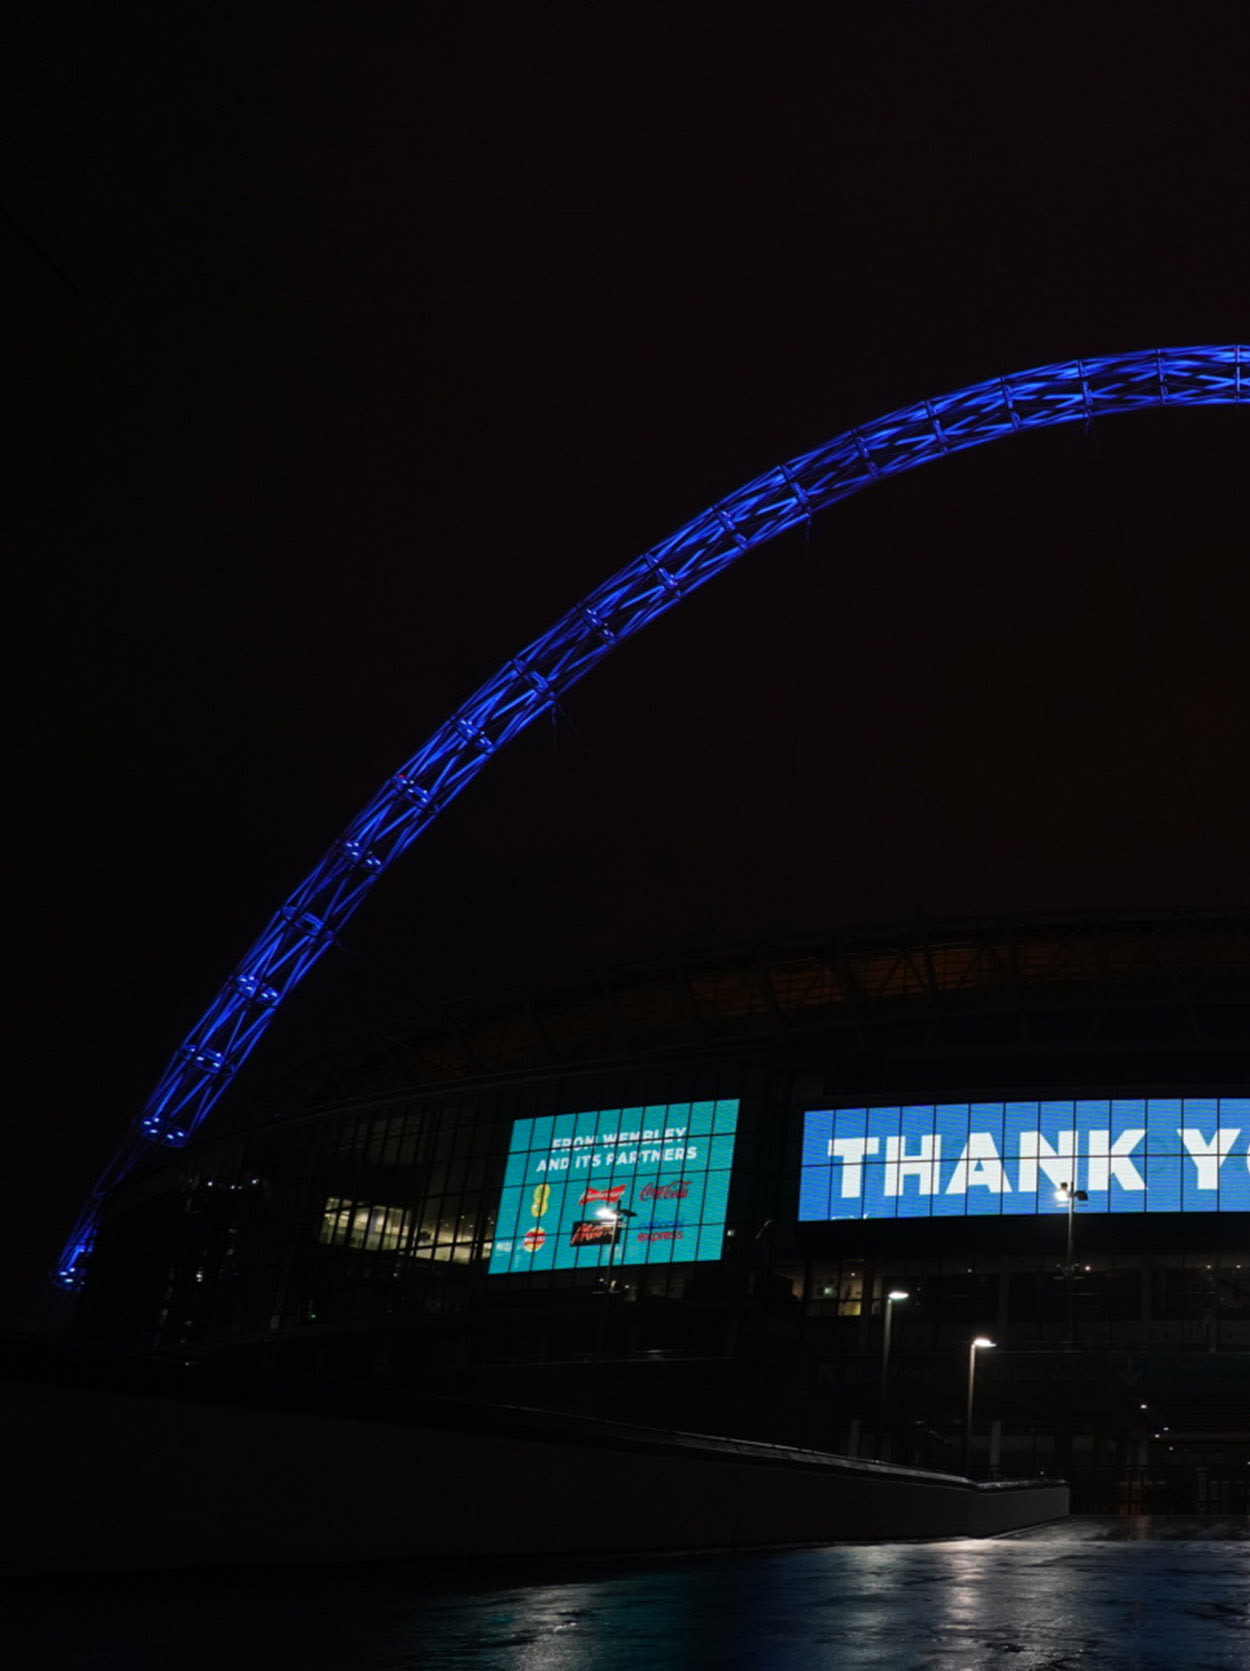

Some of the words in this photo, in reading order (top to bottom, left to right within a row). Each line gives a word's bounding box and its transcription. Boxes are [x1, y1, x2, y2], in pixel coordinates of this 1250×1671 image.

[551, 1135, 599, 1153] FROM
[603, 1127, 687, 1148] WEMBLEY
[536, 1157, 570, 1173] AND
[575, 1154, 602, 1169] ITS
[606, 1146, 698, 1167] PARTNERS
[827, 1129, 1149, 1198] THANK
